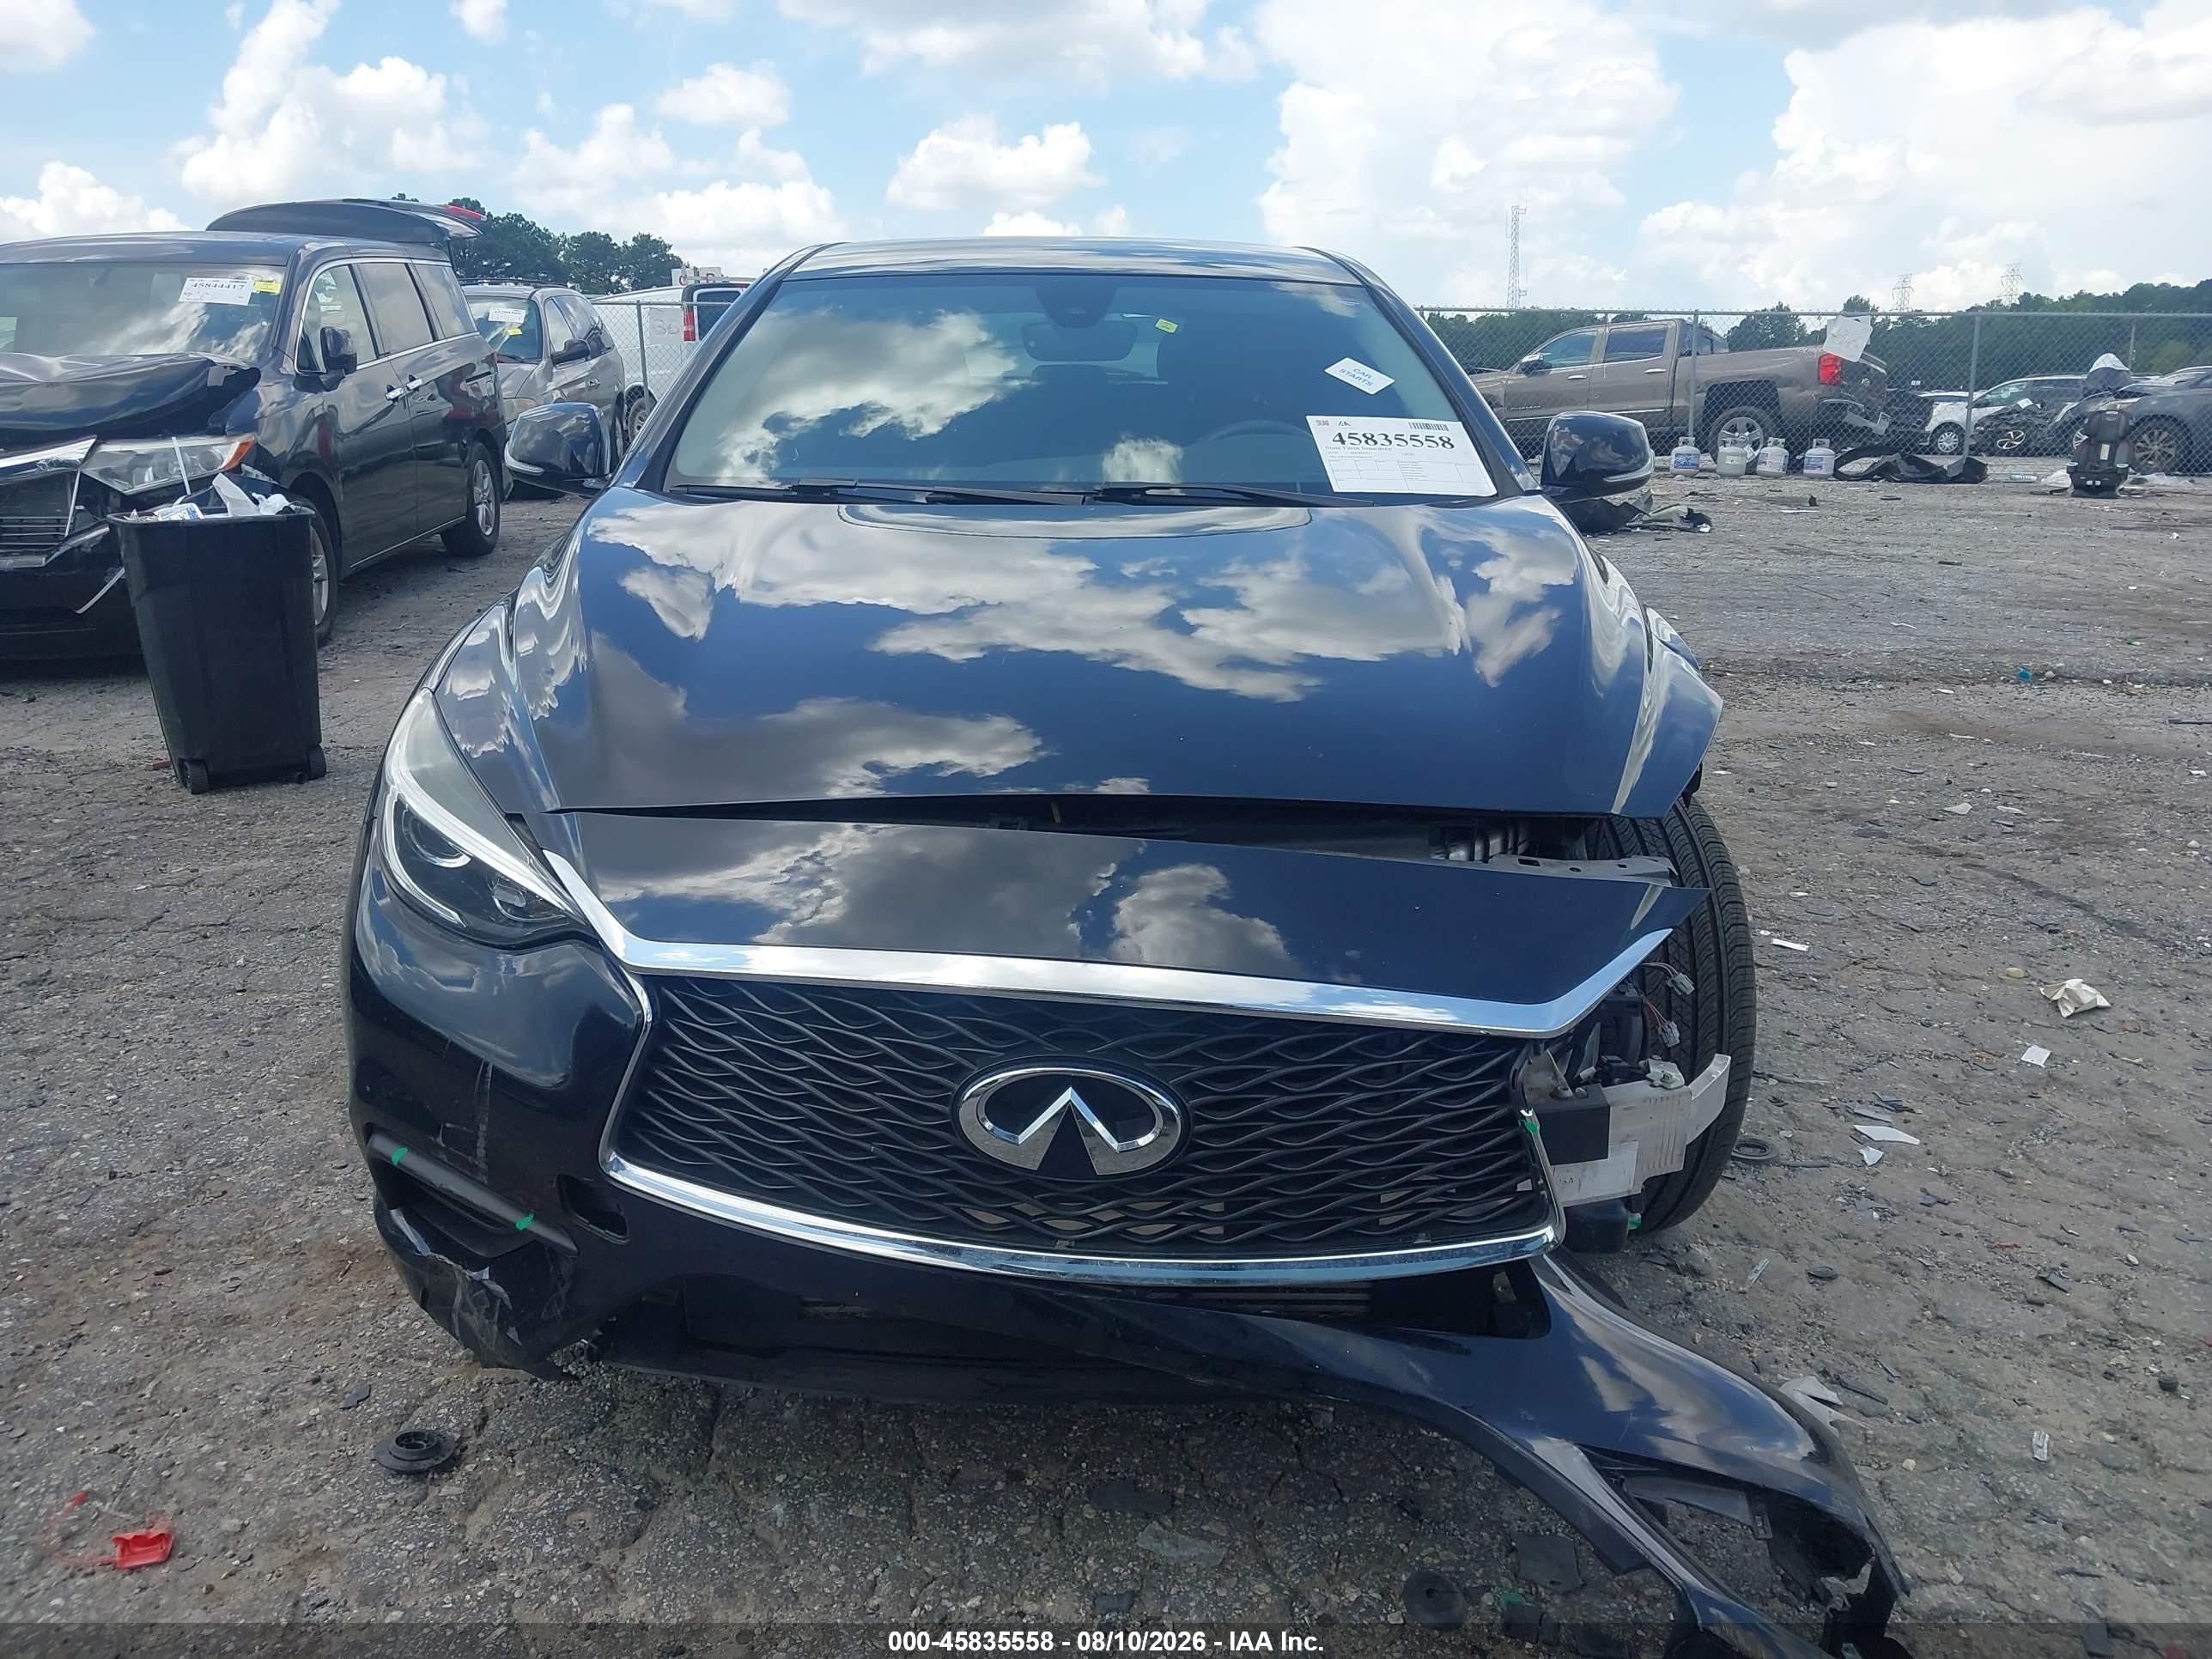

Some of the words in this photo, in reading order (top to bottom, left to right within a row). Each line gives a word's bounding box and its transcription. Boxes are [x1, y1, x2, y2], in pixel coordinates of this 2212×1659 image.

[1340, 368, 1373, 386] STARTS
[1353, 368, 1372, 380] CAR
[1332, 432, 1455, 450] 45835558
